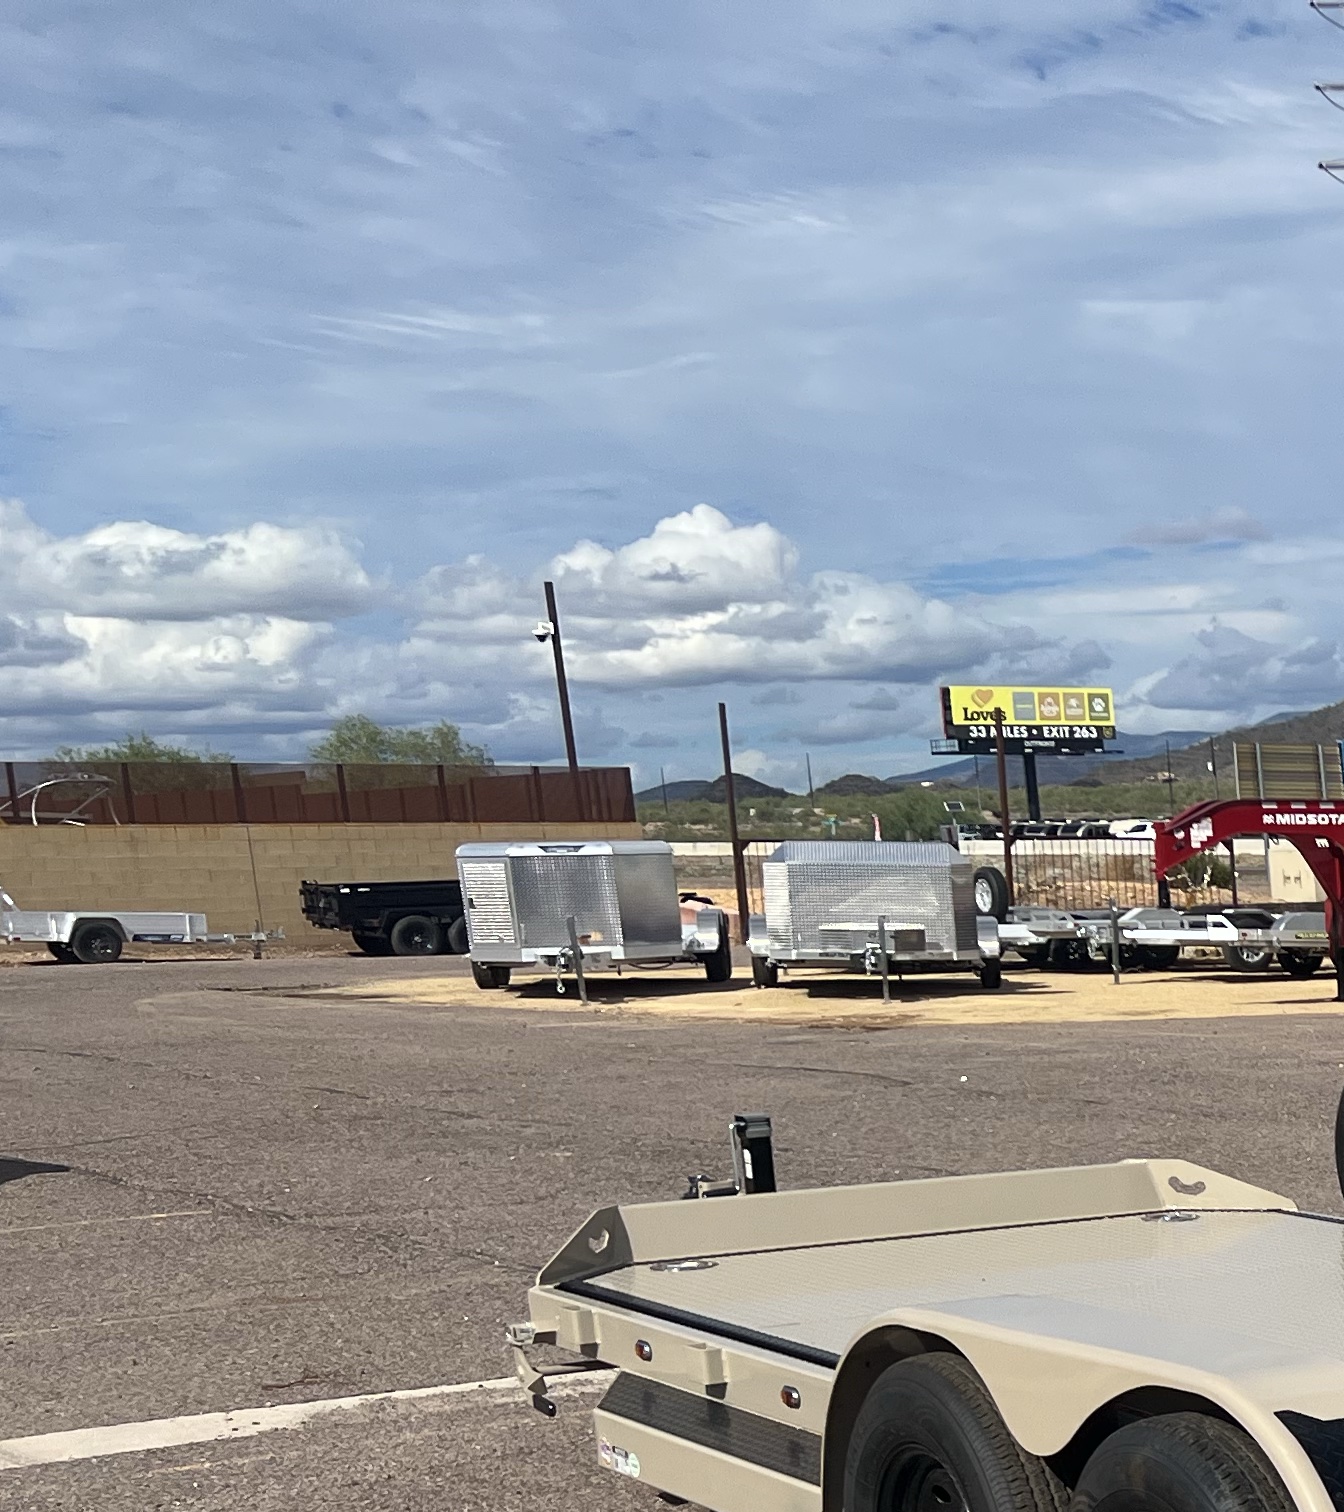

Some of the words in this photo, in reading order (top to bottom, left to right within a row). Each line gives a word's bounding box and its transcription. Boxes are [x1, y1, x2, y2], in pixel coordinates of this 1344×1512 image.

[969, 726, 986, 738] 33
[1042, 726, 1069, 738] EXIT
[1073, 726, 1098, 738] 263
